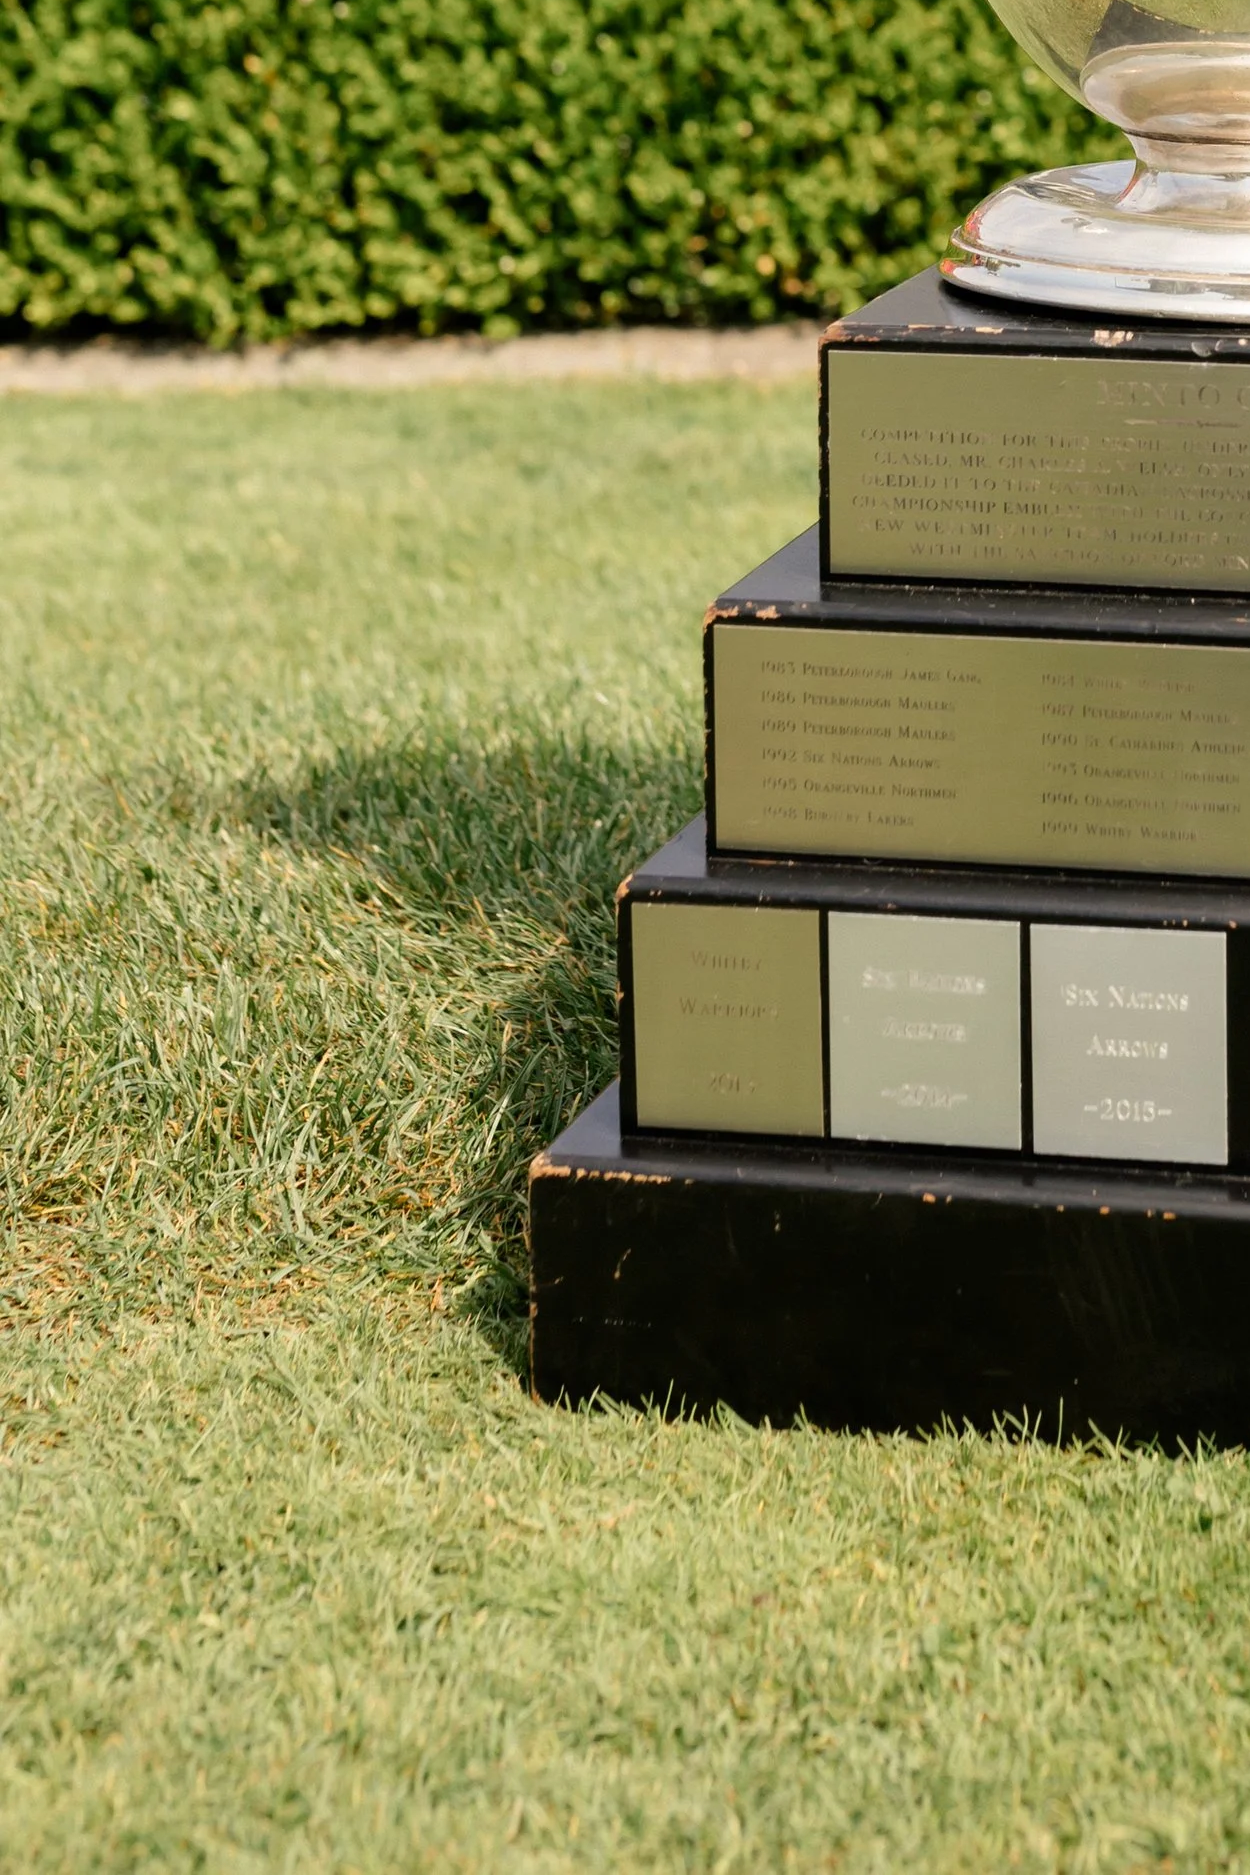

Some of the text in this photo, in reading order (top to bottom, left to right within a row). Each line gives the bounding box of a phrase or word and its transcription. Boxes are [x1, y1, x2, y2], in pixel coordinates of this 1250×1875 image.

[1096, 381, 1220, 409] MINTO
[1002, 432, 1037, 447] FOR
[861, 473, 936, 489] DEEDED
[943, 476, 960, 490] IT
[969, 477, 997, 492] TO
[852, 495, 996, 514] CHAMPIONSHIP
[909, 543, 962, 556] WITH
[902, 668, 941, 682] JAMES
[761, 690, 955, 713] 1986 PETERBOROUGH MAULERS
[761, 718, 956, 741] 1989 PETERBOROUGH MAULERS
[1041, 732, 1078, 746] 1990
[761, 748, 941, 769] 1992 SIX NATIONS ARROWS
[804, 779, 886, 796] ORANGEVILLE
[892, 784, 957, 799] NORTHMEN
[692, 950, 763, 971] WHITBY
[1065, 983, 1189, 1011] SIX NATIONS
[1086, 1033, 1168, 1059] ARROWS
[1084, 1098, 1172, 1123] -2015-
